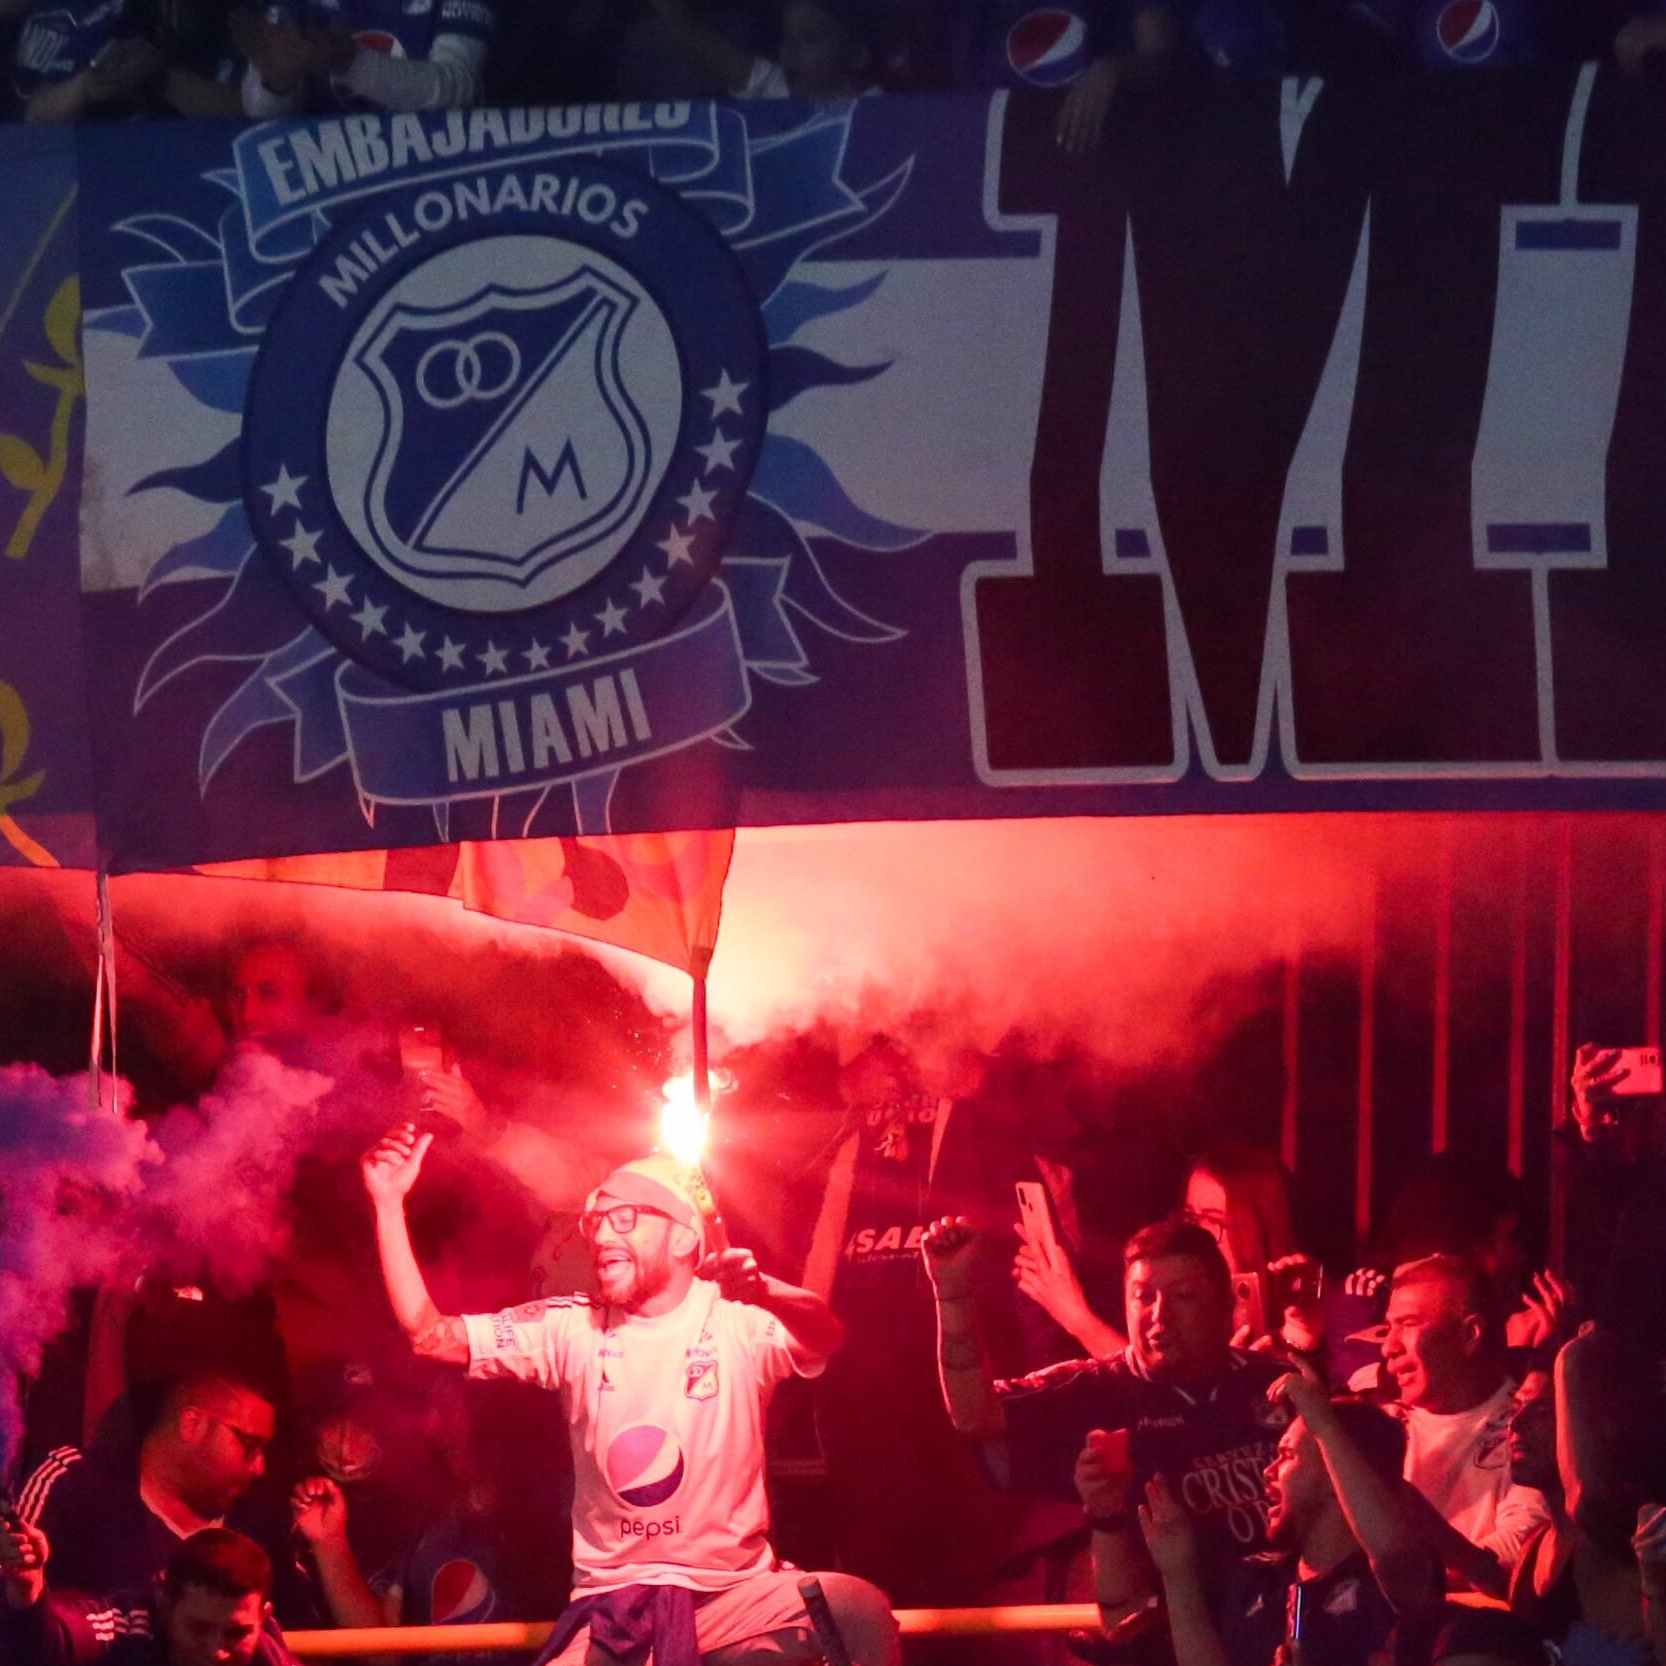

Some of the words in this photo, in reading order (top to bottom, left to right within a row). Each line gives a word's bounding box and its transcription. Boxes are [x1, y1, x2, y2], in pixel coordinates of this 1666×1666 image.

[317, 174, 651, 312] MILLONARIOS
[442, 667, 653, 783] MIAMI
[620, 1515, 684, 1541] pepsi
